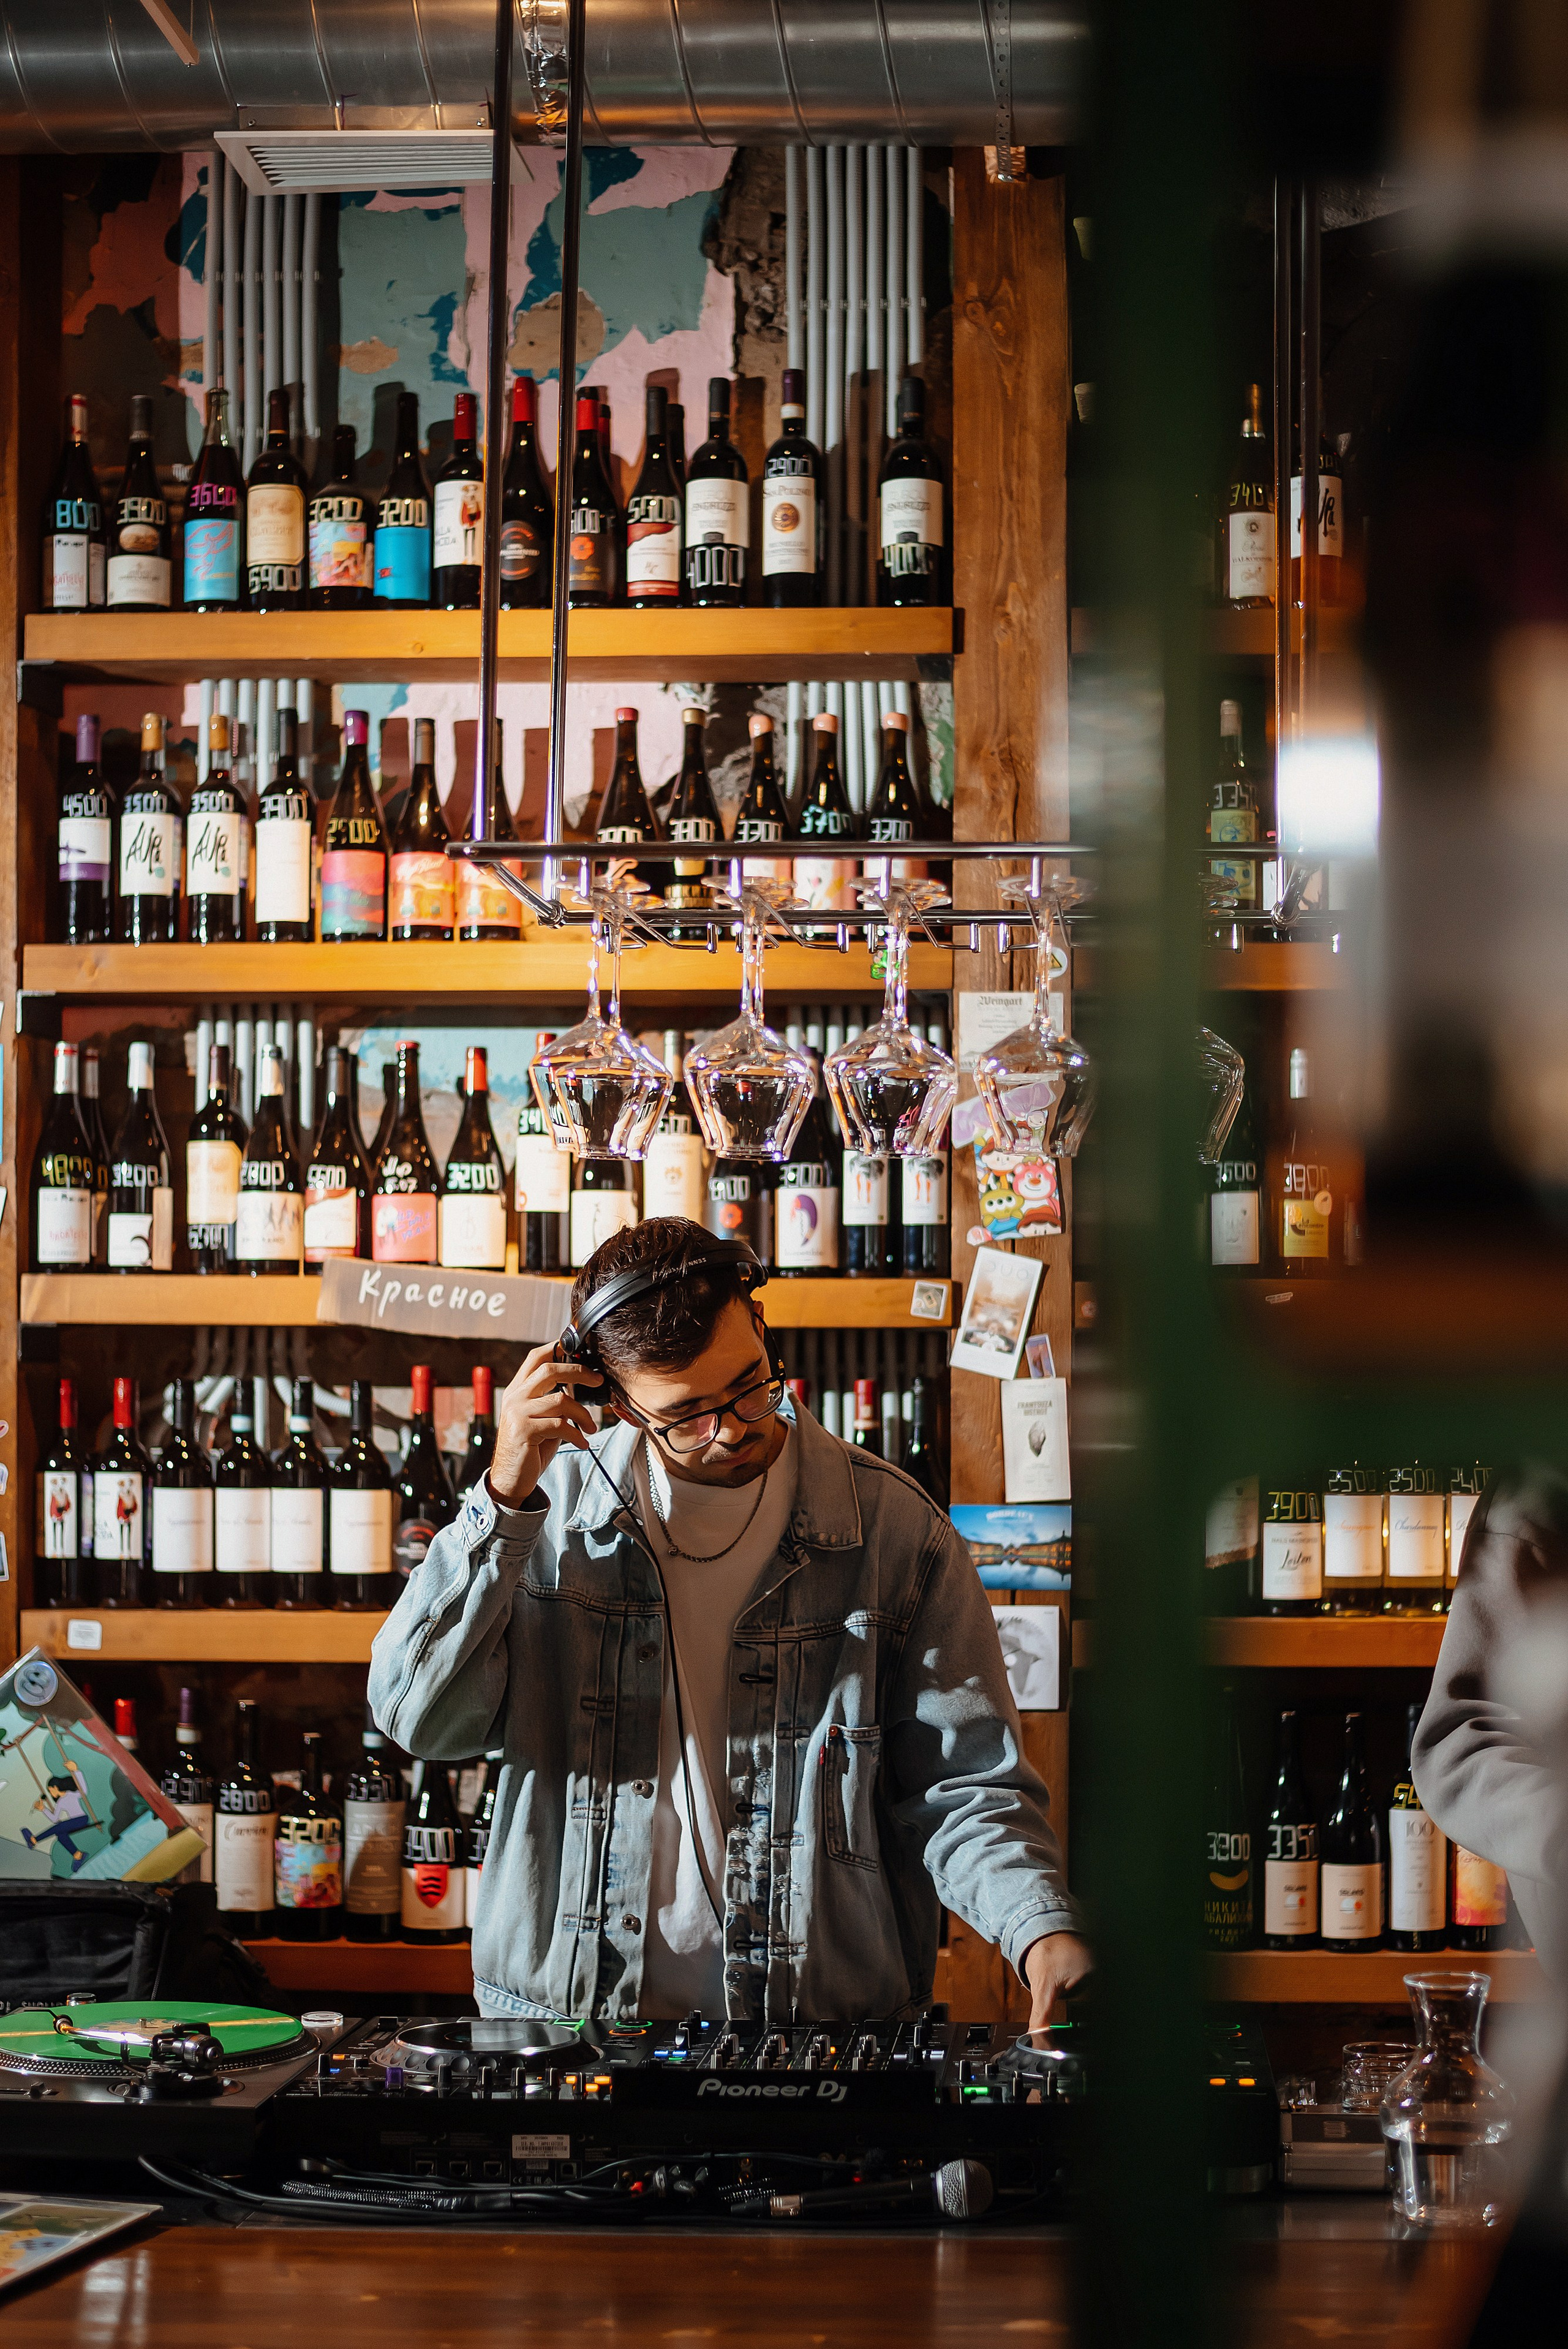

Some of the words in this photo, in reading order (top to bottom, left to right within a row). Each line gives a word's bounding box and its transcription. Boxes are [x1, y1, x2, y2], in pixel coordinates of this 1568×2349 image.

[309, 497, 363, 524] 3200
[376, 498, 428, 527] 3200
[247, 565, 301, 594] 6900
[62, 793, 108, 817] 4500
[124, 792, 167, 813] 3500
[191, 791, 235, 813] 3500
[446, 1162, 500, 1190] 3200
[358, 1269, 507, 1318] Красное
[219, 1787, 272, 1812] 2800
[279, 1815, 341, 1844] 3200
[697, 2078, 810, 2097] Pioneer
